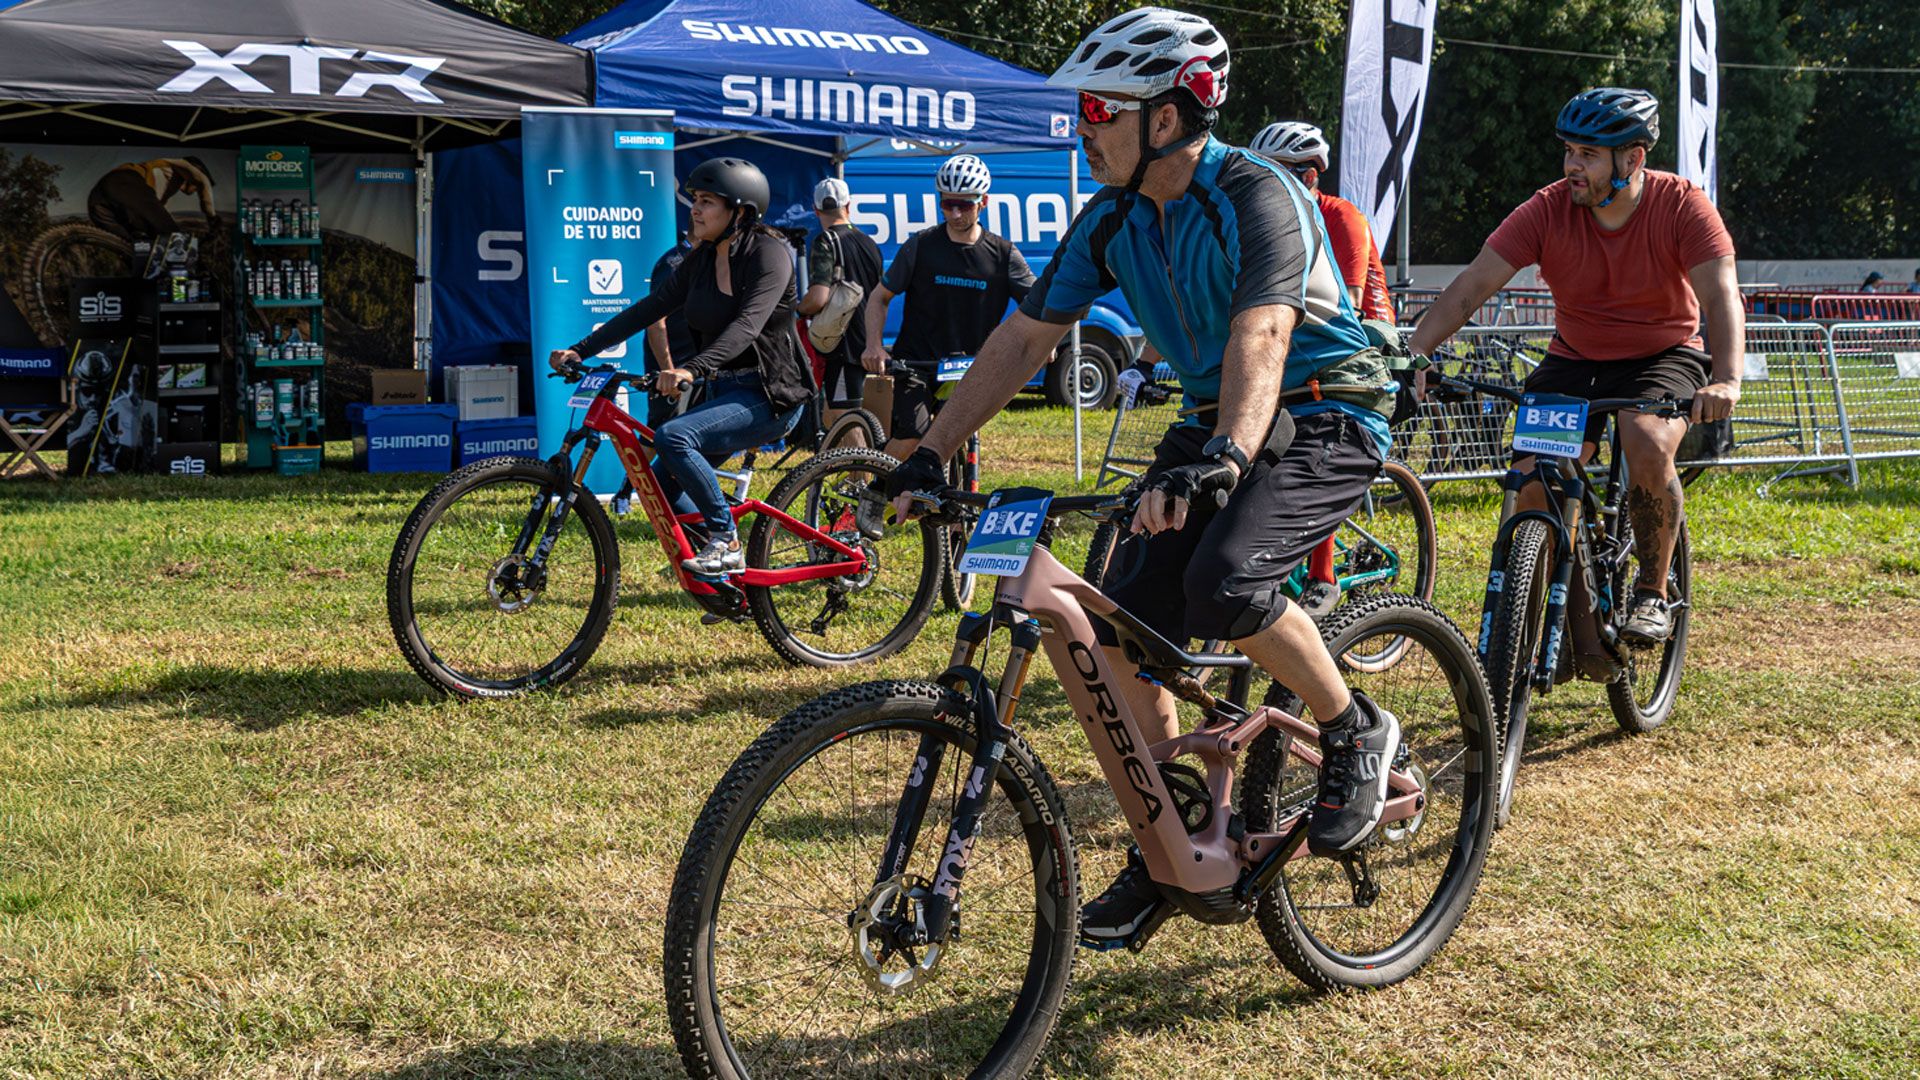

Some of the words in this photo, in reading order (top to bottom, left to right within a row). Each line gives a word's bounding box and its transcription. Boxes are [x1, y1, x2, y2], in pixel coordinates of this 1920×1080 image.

[681, 20, 930, 55] SHIMANO
[157, 40, 446, 104] XTR
[722, 74, 976, 131] SHIMANO
[619, 136, 665, 145] SHIMANO
[245, 161, 304, 172] MOTOREX
[359, 171, 405, 180] SHIMANO
[562, 207, 643, 222] CUIDANDO
[564, 225, 584, 239] DE
[587, 226, 607, 239] TU
[612, 226, 641, 239] BICI
[935, 275, 987, 290] SHIMANO
[0, 358, 51, 368] HIMANO
[472, 396, 504, 404] SHIMANO
[371, 434, 450, 449] SHIMANO
[464, 438, 538, 455] SHIMANO
[1521, 440, 1575, 454] SHIMANO
[624, 447, 680, 556] ORBEA
[966, 557, 1020, 571] SHIMANO
[1067, 641, 1163, 824] ORBEA
[1004, 756, 1055, 826] AGARRO
[933, 829, 977, 900] FOX
